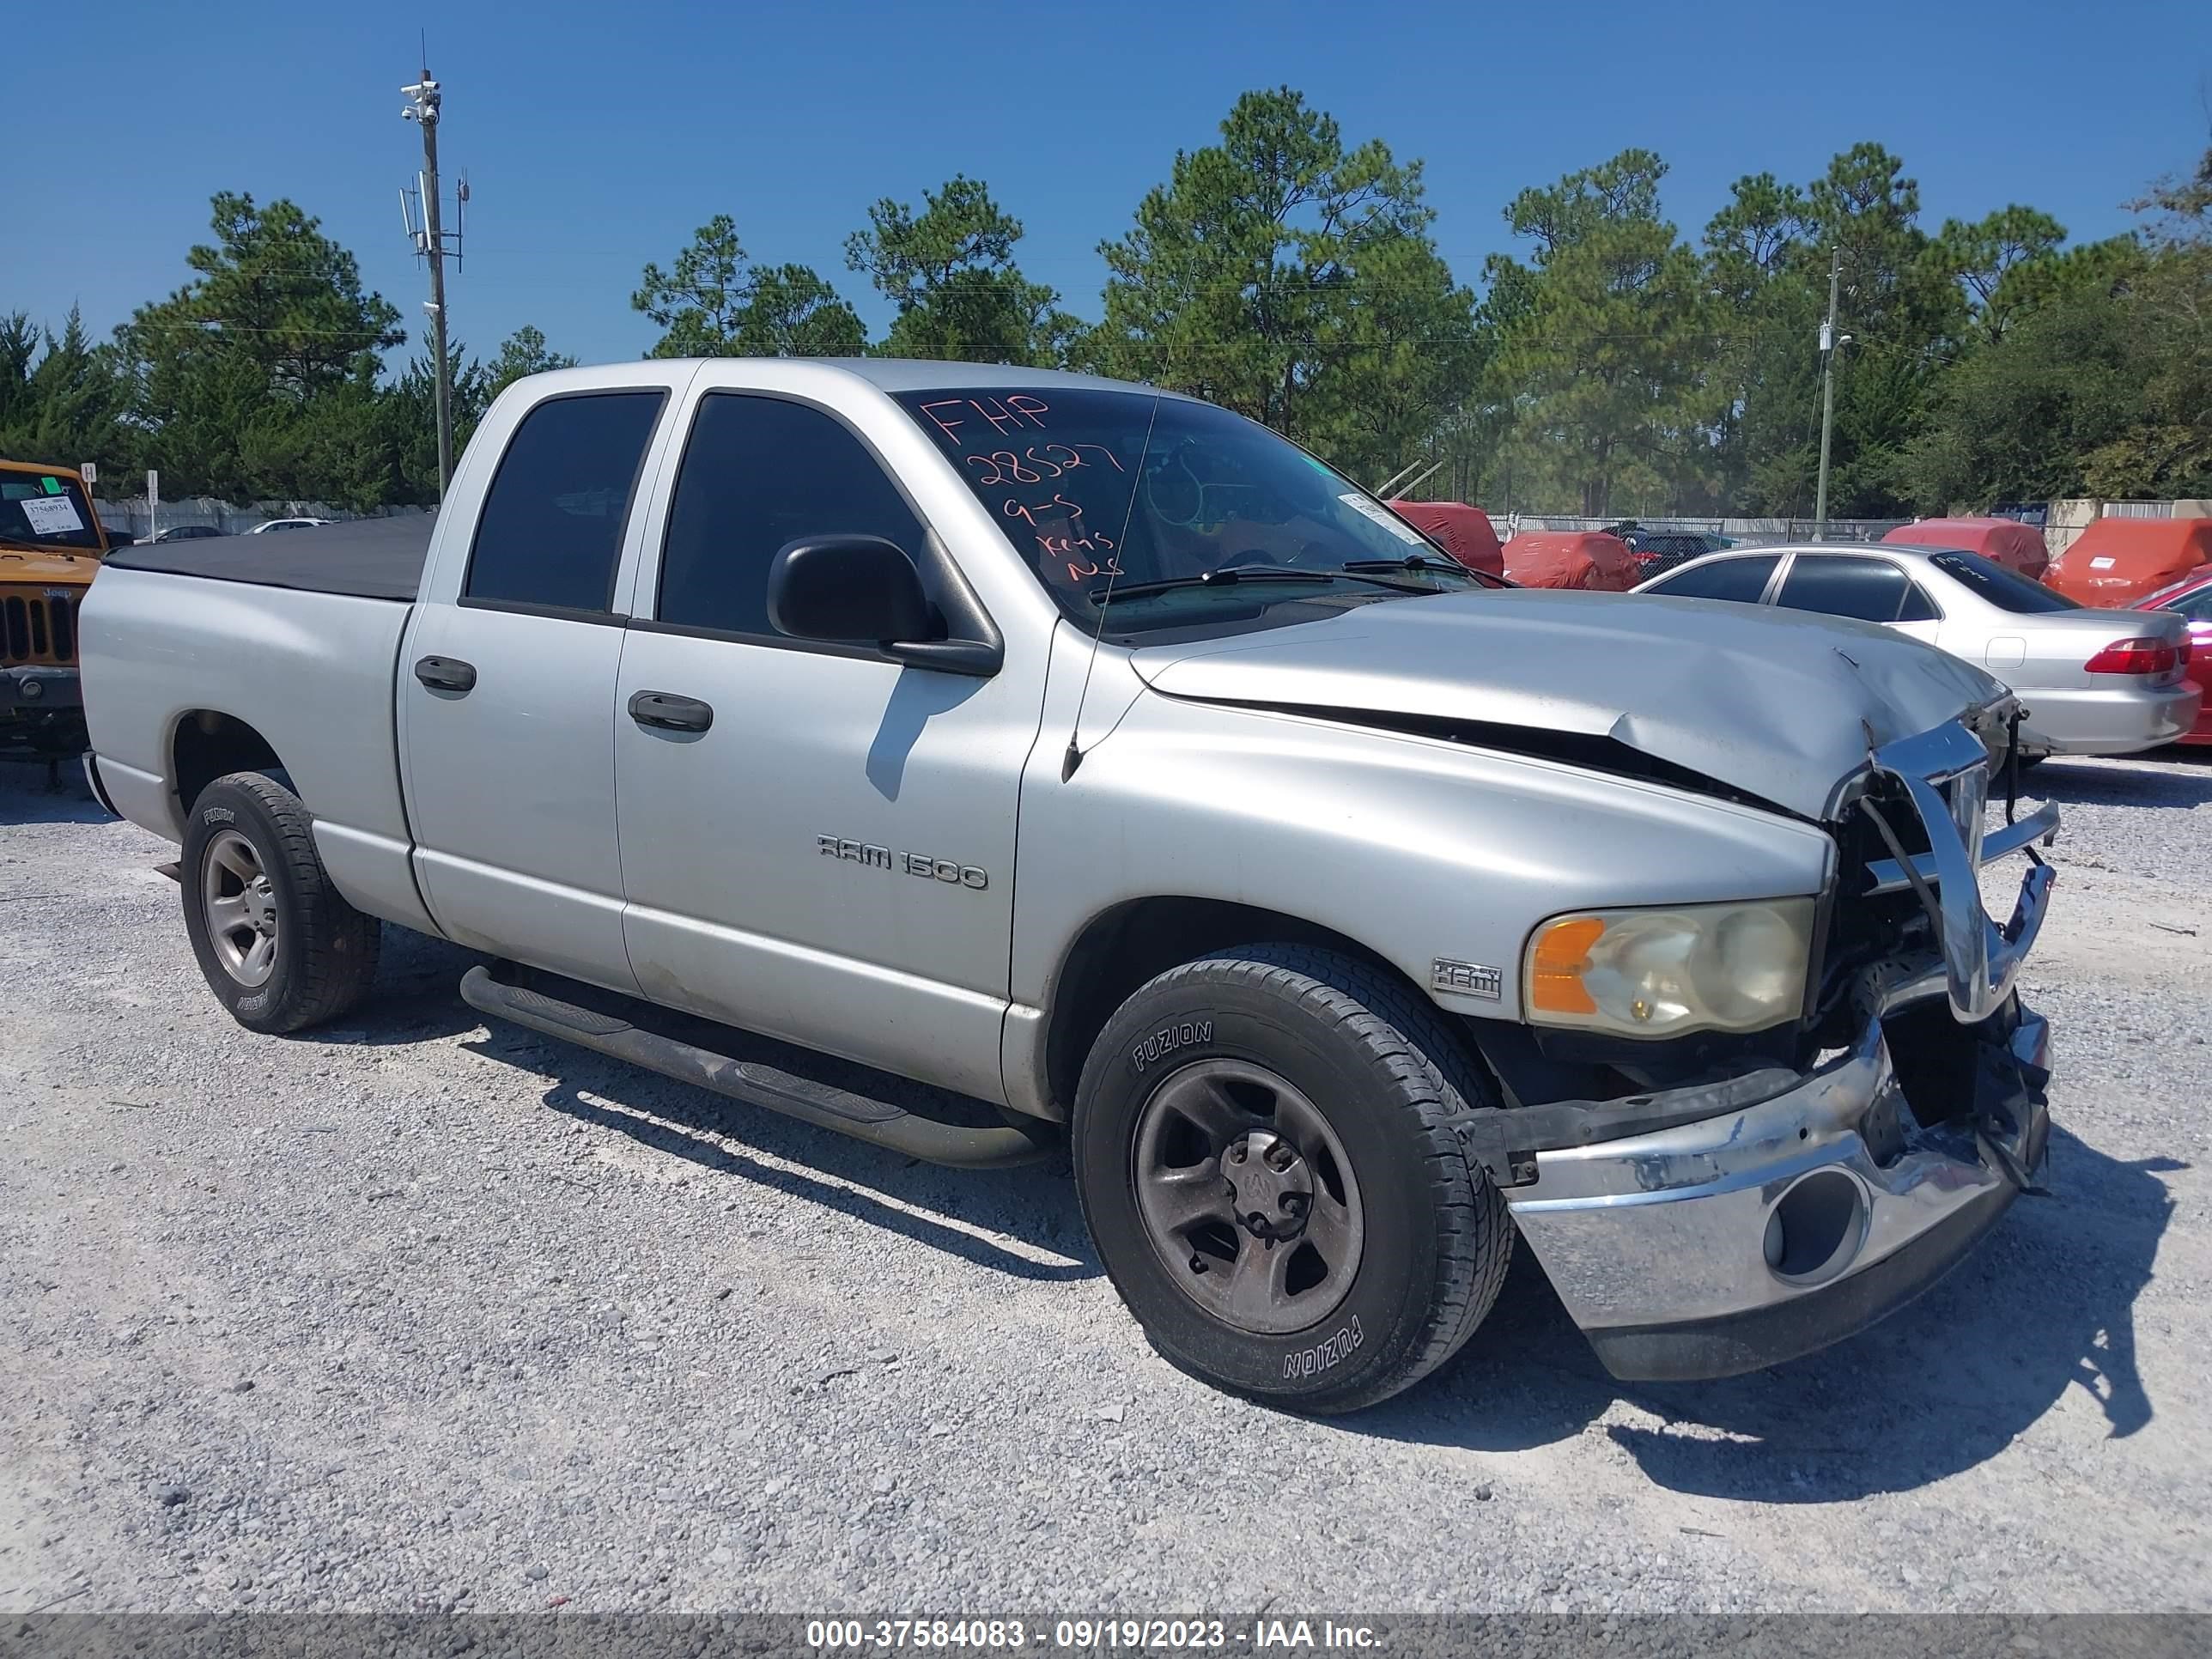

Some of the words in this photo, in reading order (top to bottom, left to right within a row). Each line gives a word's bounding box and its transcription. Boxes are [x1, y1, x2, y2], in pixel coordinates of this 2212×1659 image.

[920, 394, 1049, 446] FHP
[84, 466, 94, 480] H
[966, 443, 1125, 486] 28527
[43, 587, 72, 599] Jeep
[203, 807, 234, 826] FUZION
[817, 833, 892, 871] RAM
[899, 850, 990, 890] 1500
[1433, 963, 1501, 994] HEMI
[1133, 1021, 1212, 1073] FUZION
[1283, 1314, 1364, 1379] FUZION
